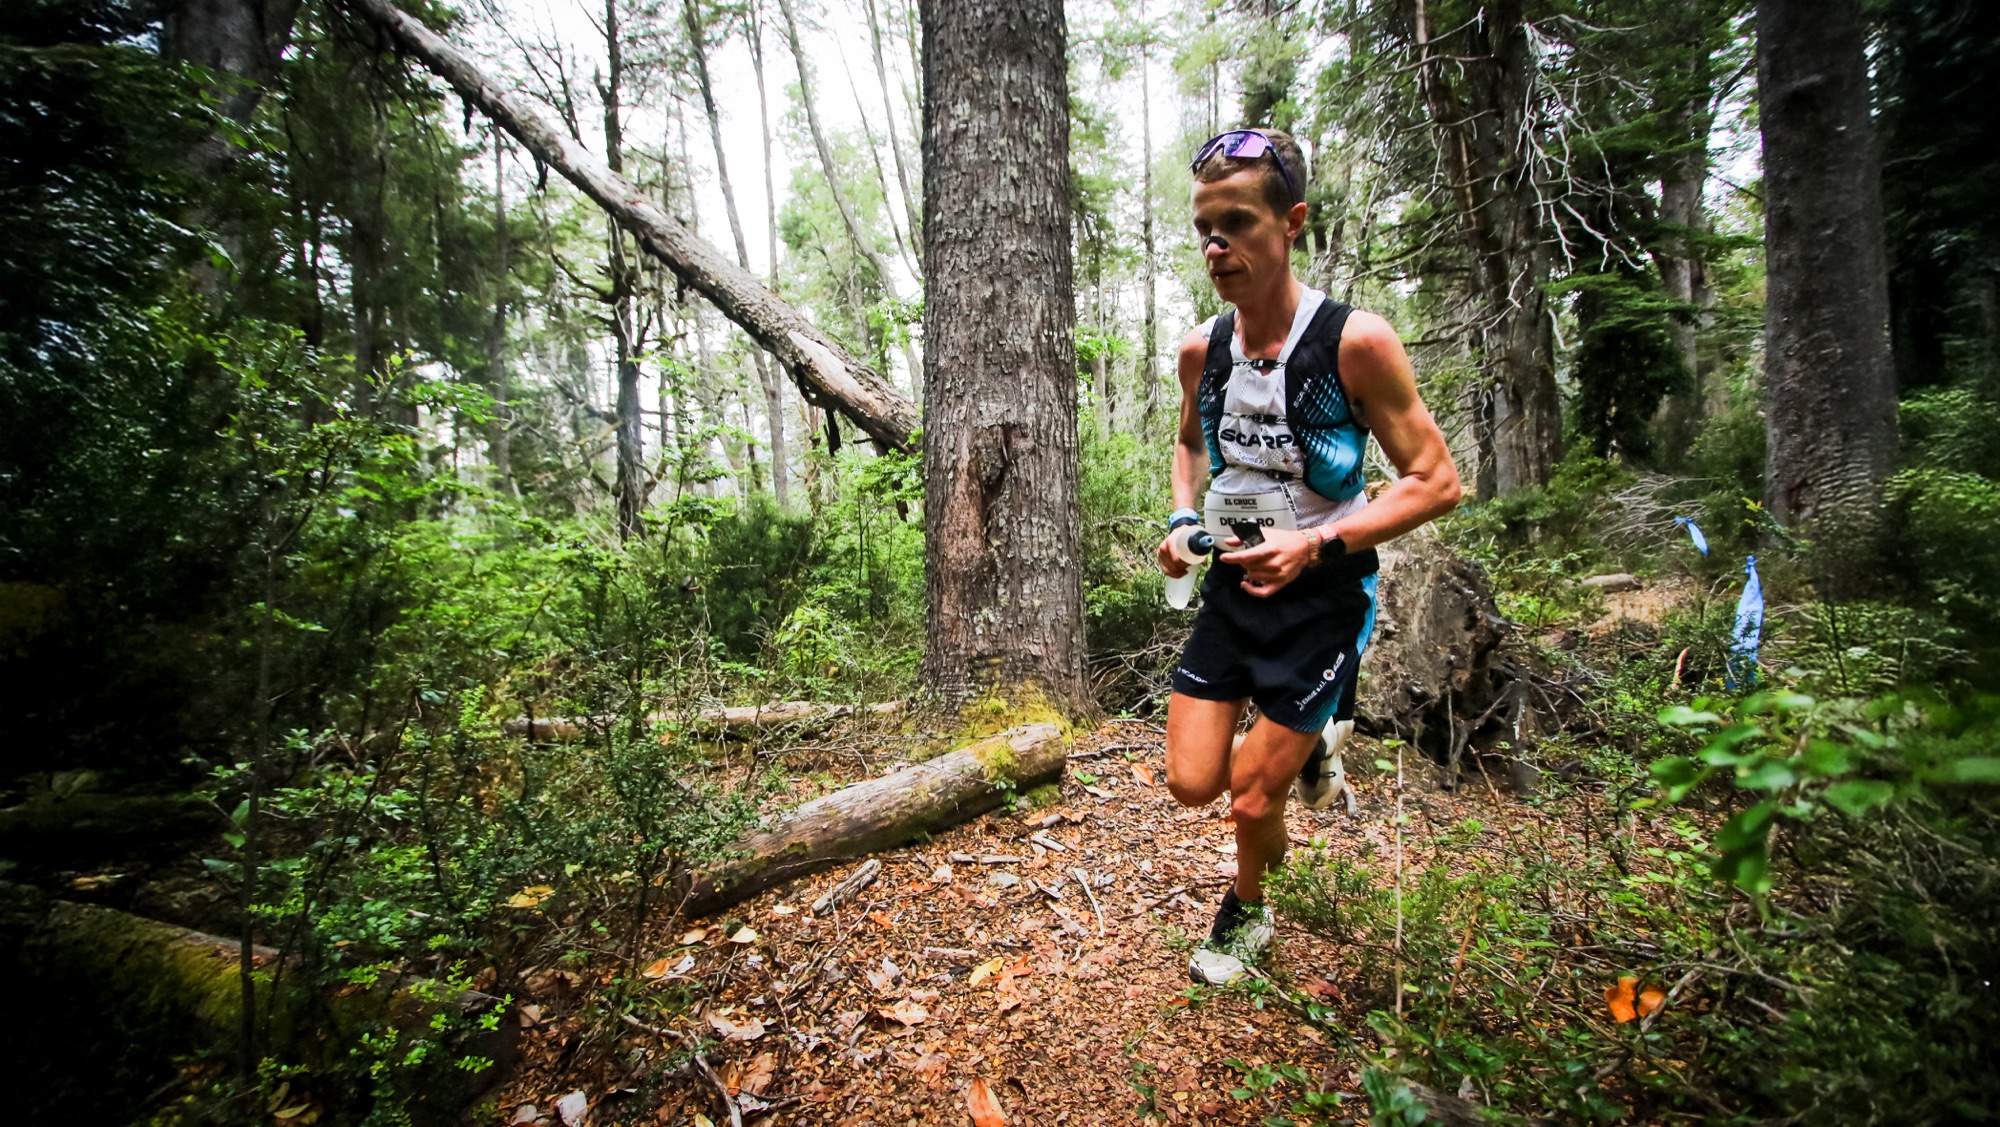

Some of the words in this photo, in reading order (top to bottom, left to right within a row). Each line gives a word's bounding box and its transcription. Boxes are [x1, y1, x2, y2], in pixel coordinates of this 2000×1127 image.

[1220, 429, 1297, 449] SCARP
[1224, 498, 1233, 506] EL
[1233, 498, 1257, 506] CRUCE
